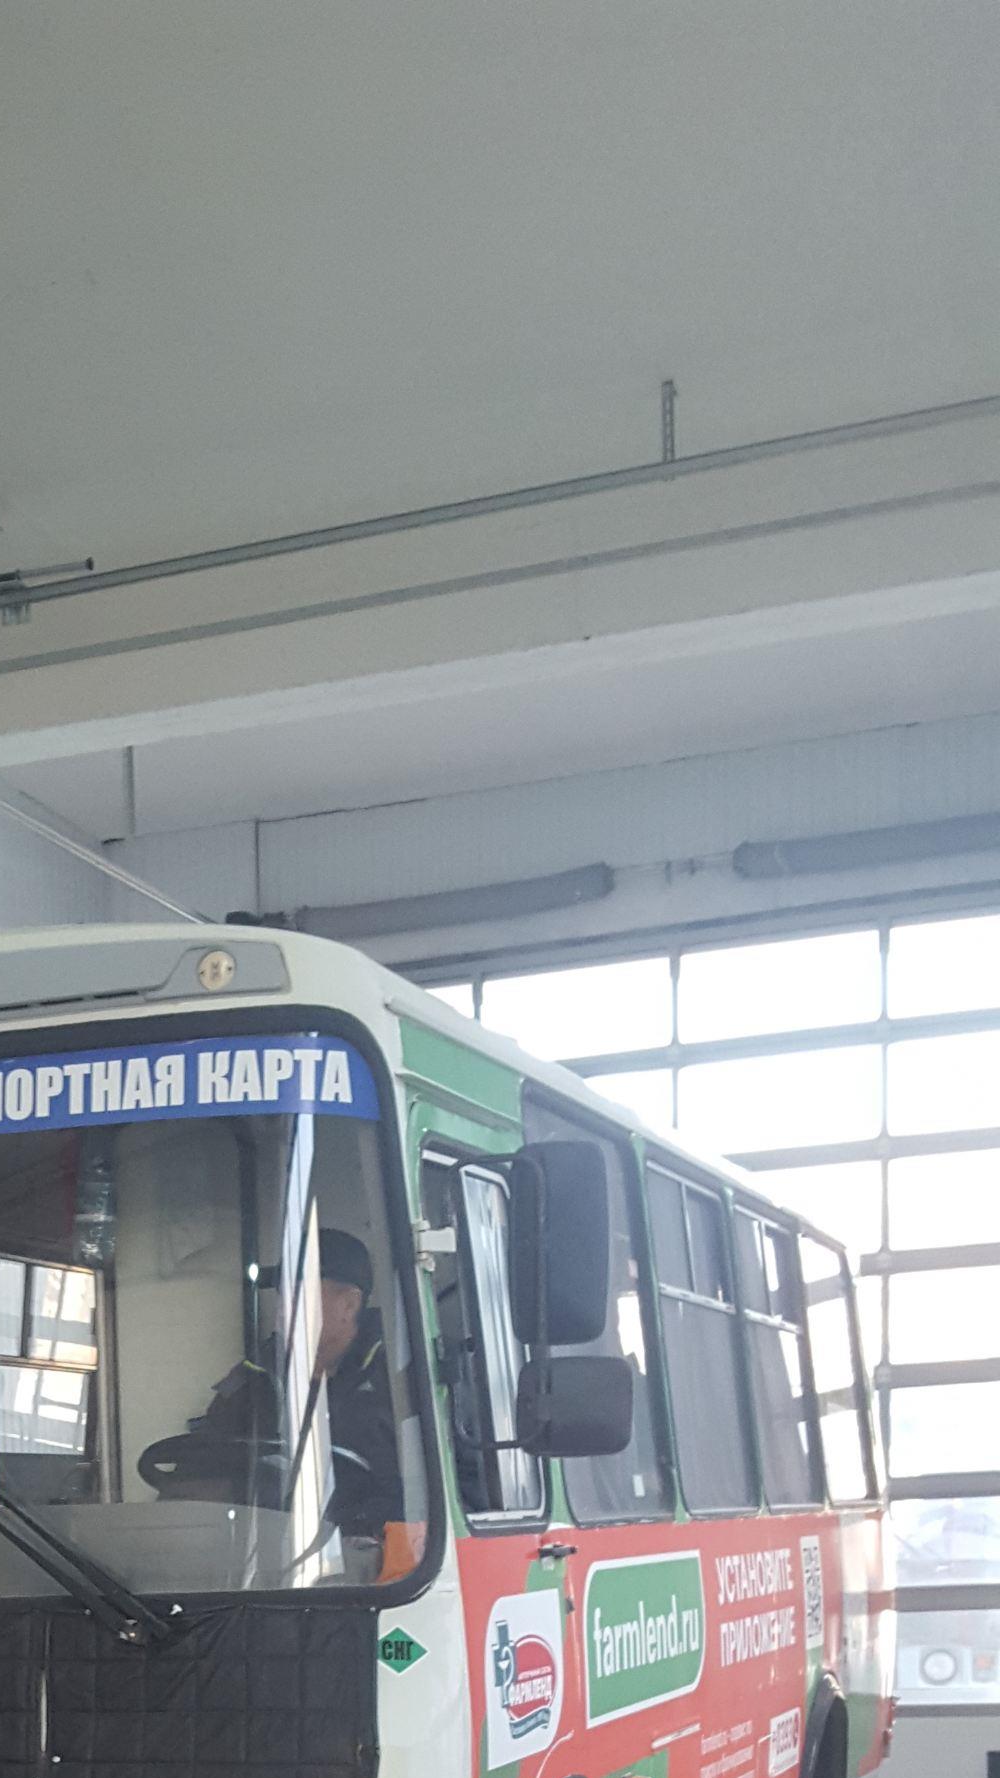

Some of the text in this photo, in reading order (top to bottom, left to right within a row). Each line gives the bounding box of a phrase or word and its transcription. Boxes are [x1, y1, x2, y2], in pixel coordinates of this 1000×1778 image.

[197, 1048, 353, 1104] КАРТА
[715, 1547, 794, 1606] УСТАНОВИТЕ
[381, 1640, 414, 1661] СНГ
[593, 1593, 699, 1678] farmlend.ru
[720, 1605, 796, 1667] ПРИЛОЖЕНИЕ
